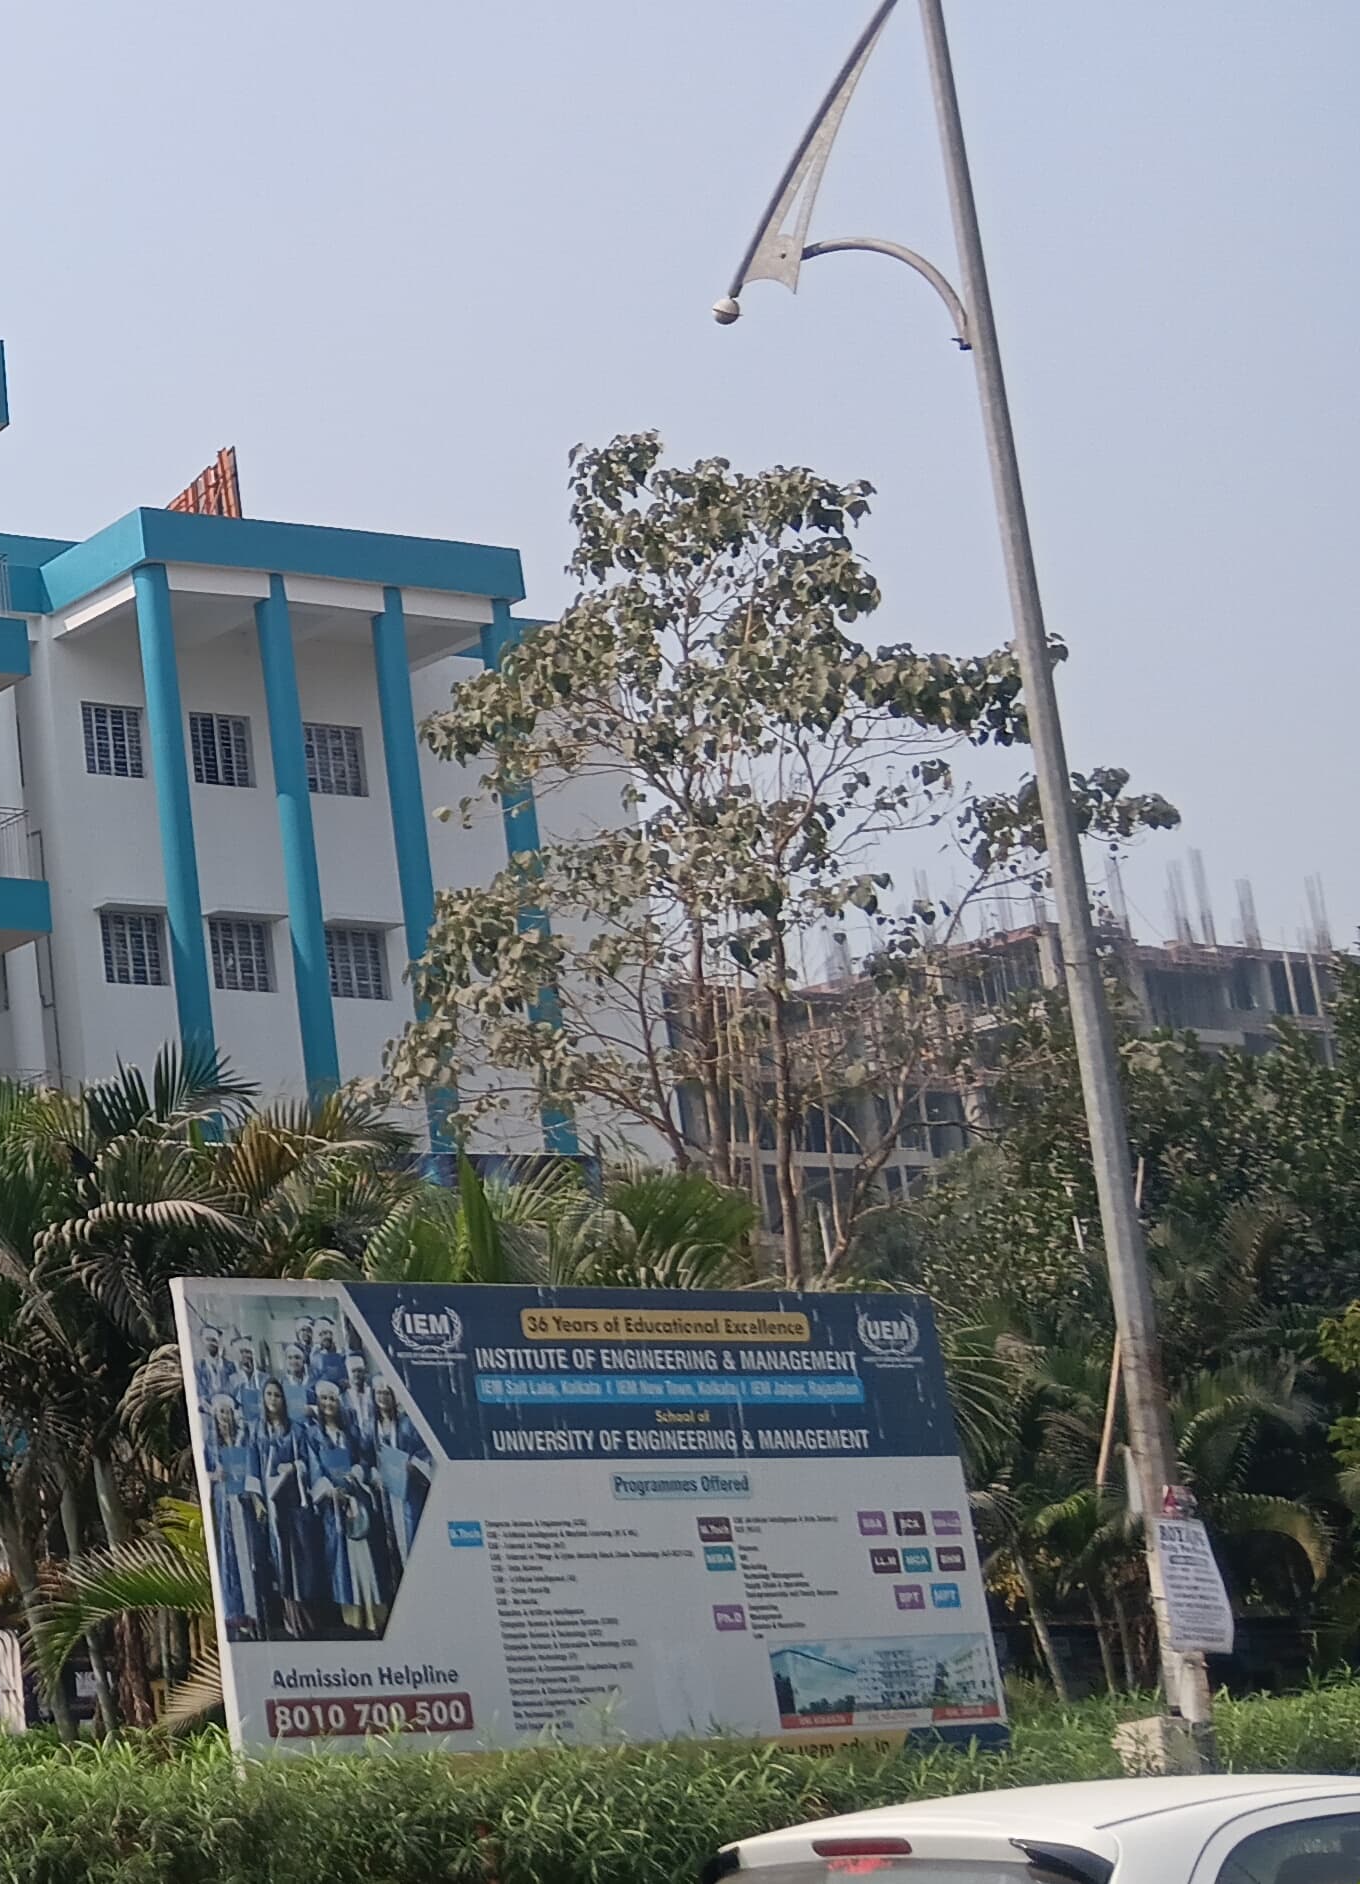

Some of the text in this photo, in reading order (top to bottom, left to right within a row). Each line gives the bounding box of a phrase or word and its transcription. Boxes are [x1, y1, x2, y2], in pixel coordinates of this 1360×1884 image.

[404, 1313, 450, 1334] IEM
[527, 1316, 805, 1336] 36 Years of Educational Excellence
[866, 1321, 909, 1341] UEM
[475, 1347, 568, 1370] INSTITUTE
[572, 1349, 596, 1370] OF
[601, 1349, 717, 1371] ENGINEERING
[722, 1350, 737, 1371] &
[740, 1350, 857, 1371] MANAGEMENT
[654, 1410, 711, 1423] School of
[492, 1429, 870, 1451] UNIVERSITY OF ENGINEERING & MANAGEMENT
[613, 1474, 750, 1496] Programmes Offered
[272, 1665, 460, 1690] Admission Helpline
[274, 1699, 466, 1732] 8010 700 500
